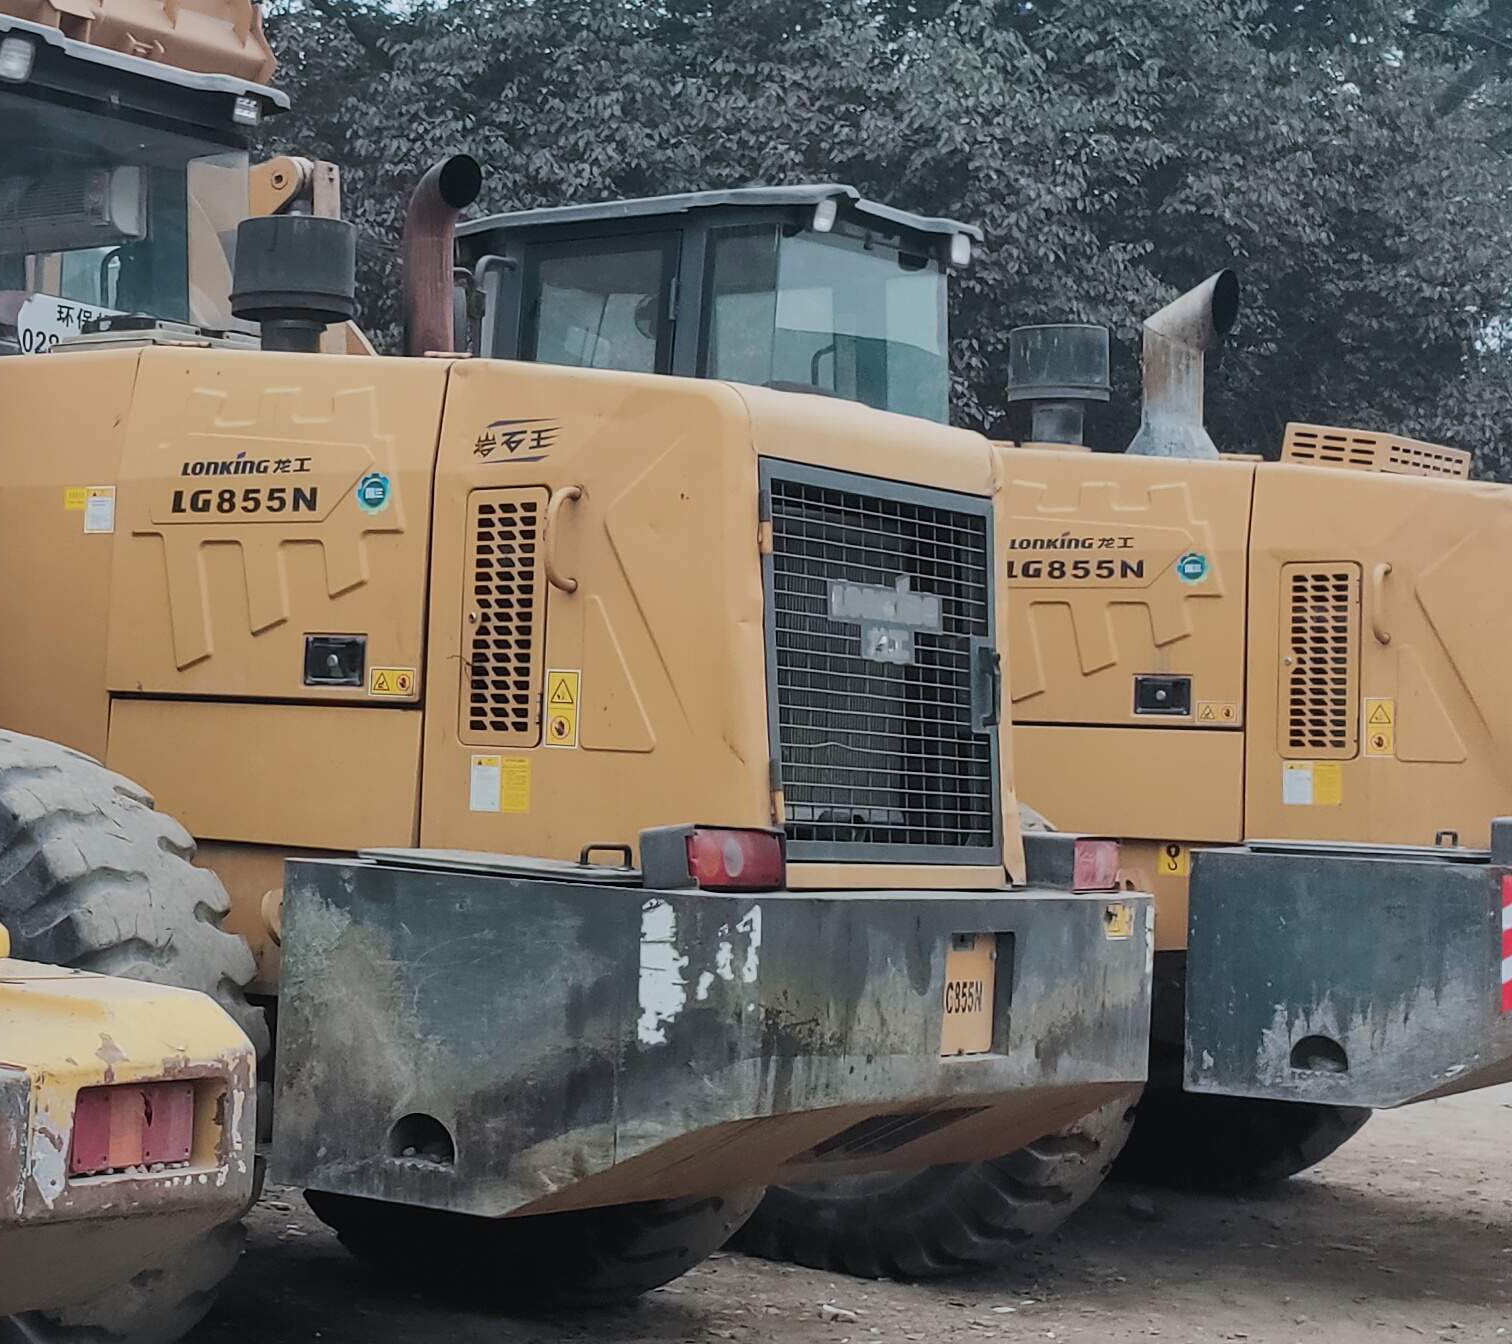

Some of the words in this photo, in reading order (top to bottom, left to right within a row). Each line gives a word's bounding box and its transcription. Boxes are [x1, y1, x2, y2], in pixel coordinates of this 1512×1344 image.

[56, 304, 104, 330] 环保
[472, 426, 563, 458] 岩石王
[272, 457, 312, 474] 龙工
[171, 487, 318, 514] LG855N
[1097, 537, 1135, 550] 龙工
[1007, 559, 1145, 579] LG855N
